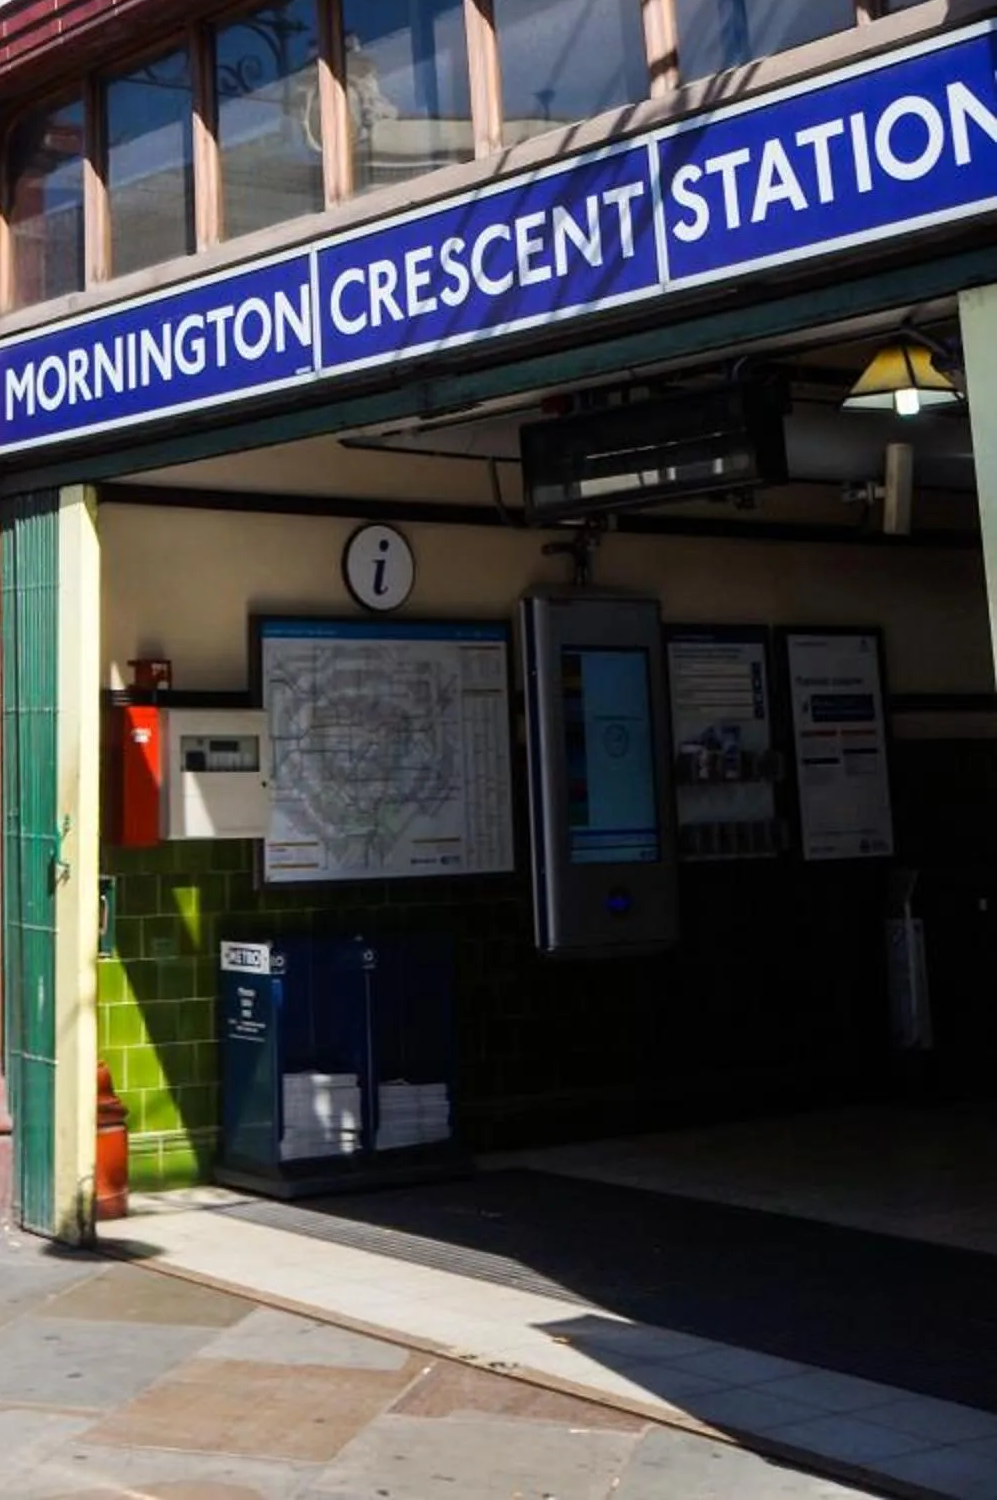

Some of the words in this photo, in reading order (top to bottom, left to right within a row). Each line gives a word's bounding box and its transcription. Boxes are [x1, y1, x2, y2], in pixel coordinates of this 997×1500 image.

[5, 283, 312, 422] MORNINGTON
[330, 180, 645, 336] CRESCENT
[671, 81, 997, 242] STATION
[228, 948, 262, 967] METRO
